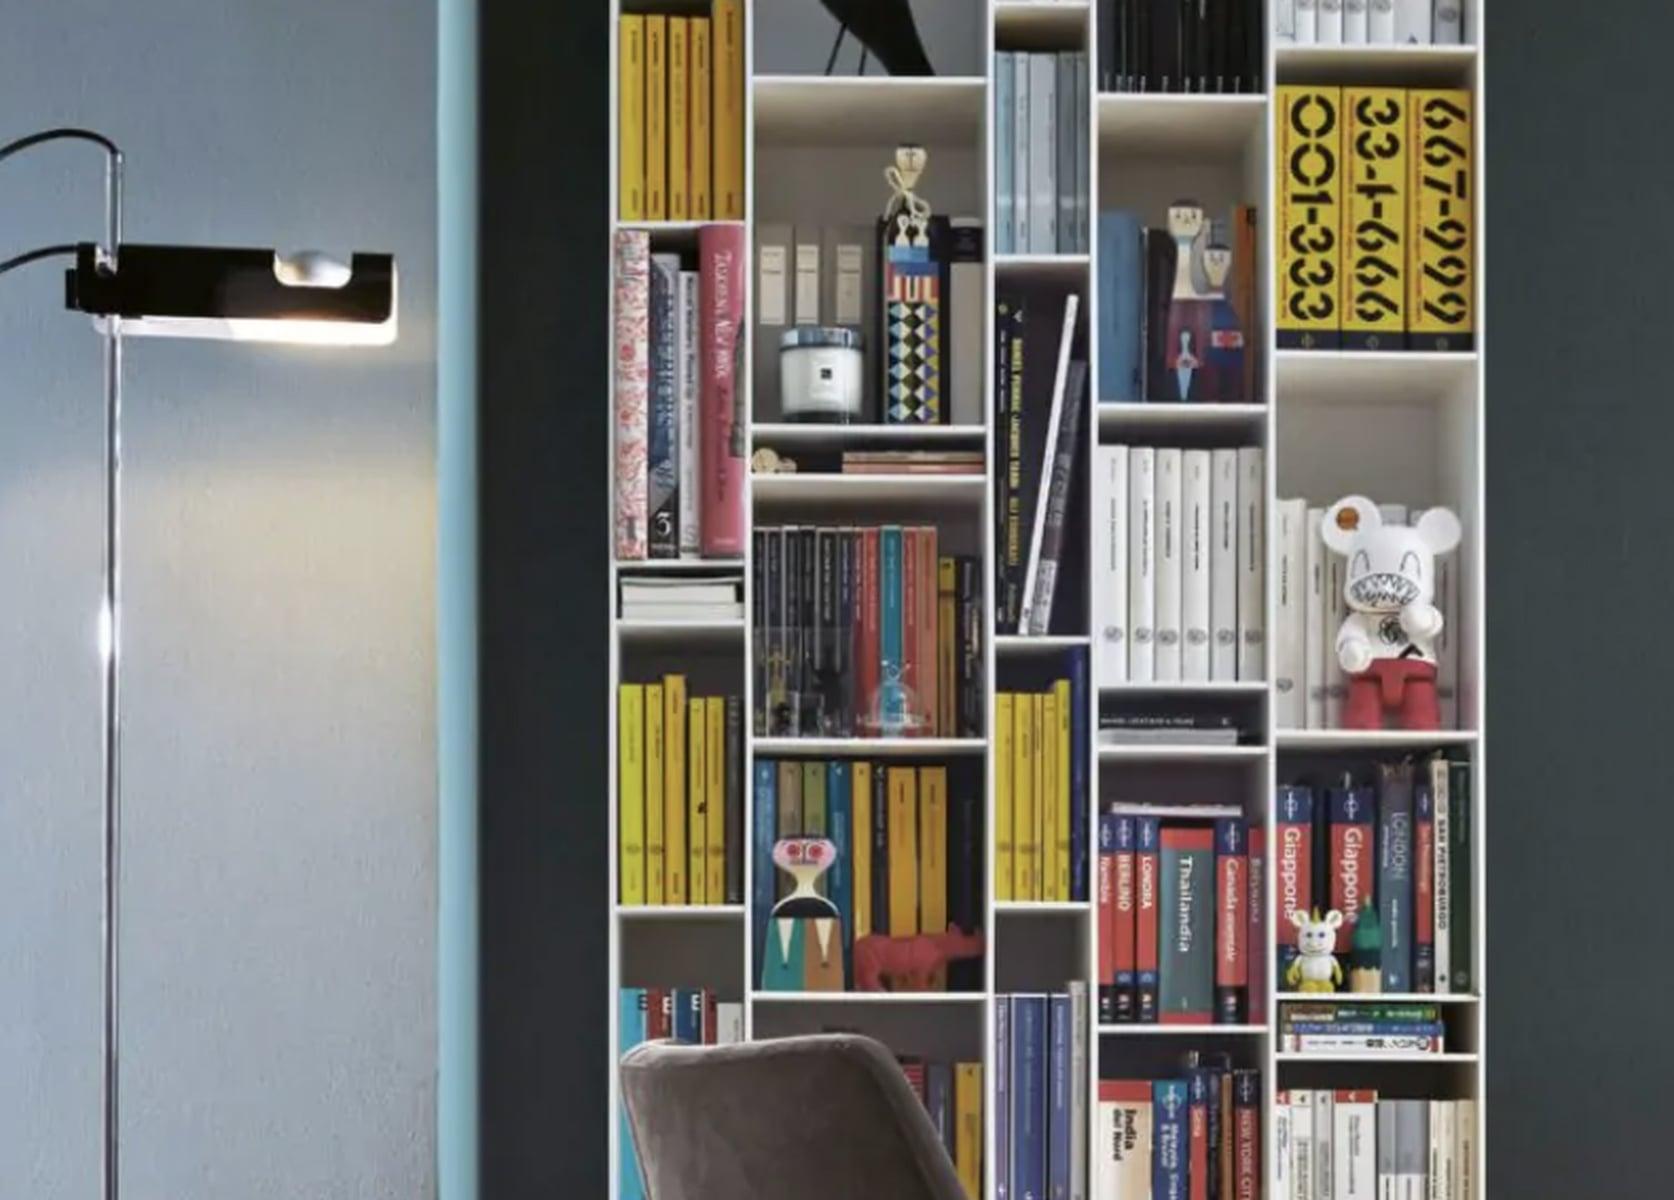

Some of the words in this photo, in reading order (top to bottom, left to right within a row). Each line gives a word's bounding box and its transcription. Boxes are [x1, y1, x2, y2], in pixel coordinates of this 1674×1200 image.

[1289, 94, 1336, 321] 001-333
[1354, 96, 1400, 323] 334-666
[1422, 98, 1467, 325] 667-999
[1141, 856, 1153, 910] LONDRA
[1177, 856, 1194, 953] Thailandia
[1113, 1131, 1124, 1161] Nord
[1124, 1109, 1138, 1150] India
